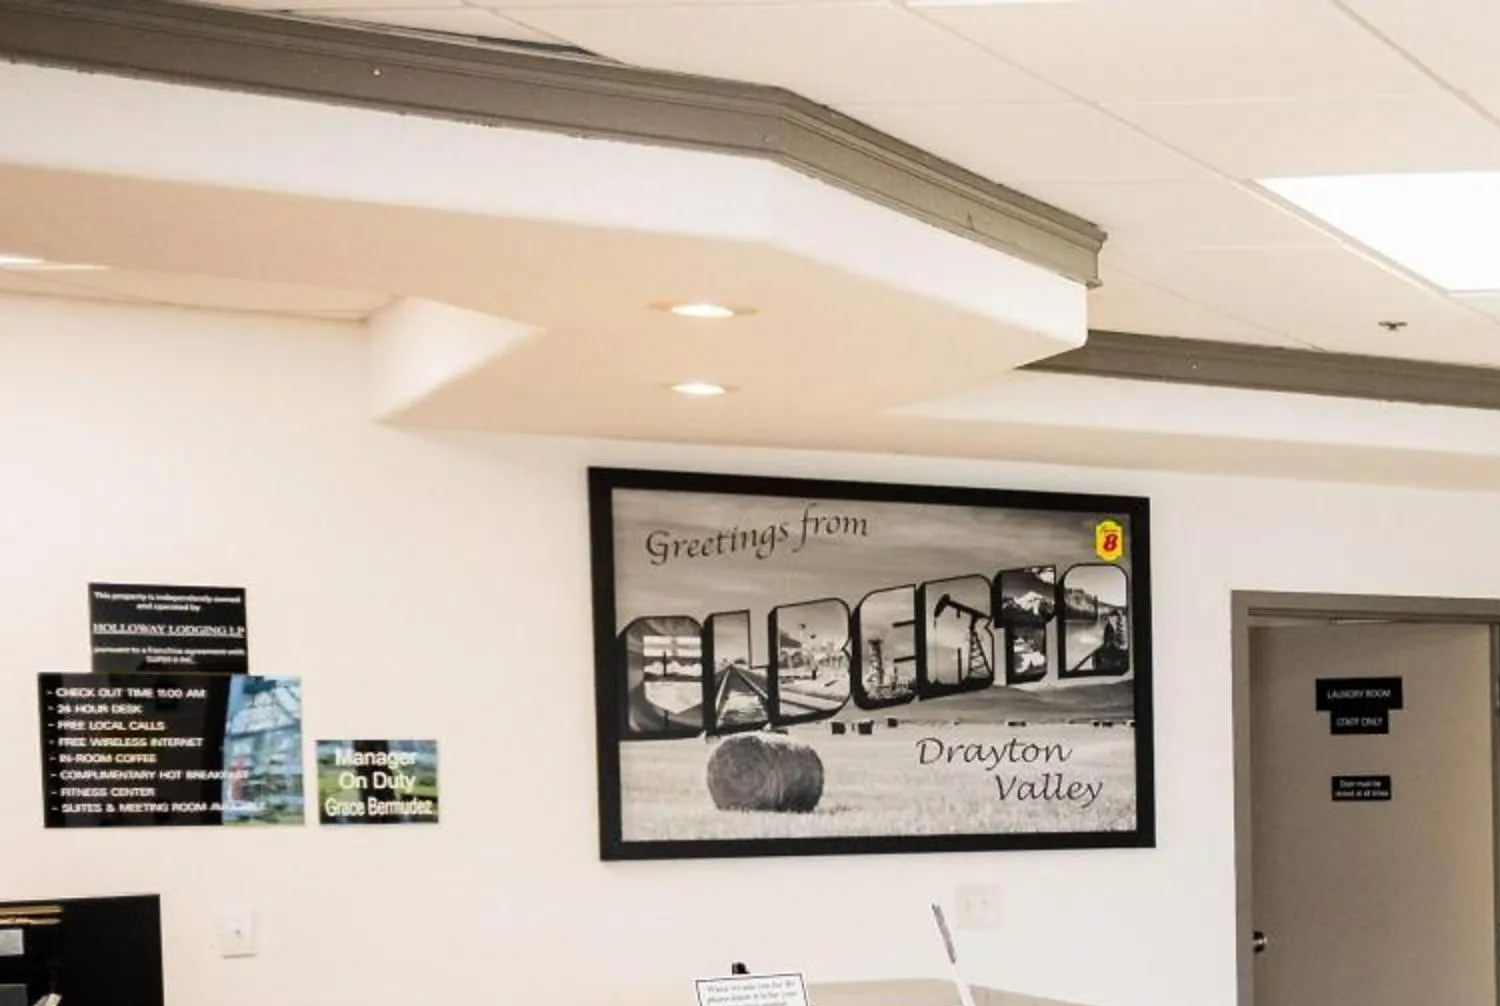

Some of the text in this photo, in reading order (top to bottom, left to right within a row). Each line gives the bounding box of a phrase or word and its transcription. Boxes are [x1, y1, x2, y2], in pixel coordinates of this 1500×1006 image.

[645, 502, 869, 565] Greetings from
[1103, 533, 1118, 552] 8
[93, 622, 165, 635] HOLLOWAY
[168, 624, 227, 636] LODGING
[616, 563, 1130, 741] ALBERTA
[56, 687, 96, 698] CHECK
[98, 687, 123, 698] OUT
[127, 687, 154, 698] TIME
[185, 688, 207, 699] AM
[1326, 688, 1392, 700] LAUNDRY ROOM
[75, 704, 110, 714] HOUR
[111, 704, 144, 714] DESK
[57, 720, 166, 731] FREE LOCAL CALLS
[1361, 716, 1383, 727] ONLY
[58, 737, 204, 748] FREE WIRELESS INTERNET
[59, 753, 158, 764] IN-ROOM COFFEE
[915, 737, 1073, 768] Drayton
[335, 748, 418, 770] Manager
[160, 770, 182, 779] HOT
[339, 770, 417, 794] On Duty
[60, 786, 157, 798] FITNESS CENTER
[993, 772, 1104, 809] Valley
[61, 803, 103, 813] SUITES
[105, 803, 116, 813] &
[119, 803, 169, 813] MEETING
[172, 803, 207, 813] ROOM
[325, 796, 434, 817] Grace Bermudez
